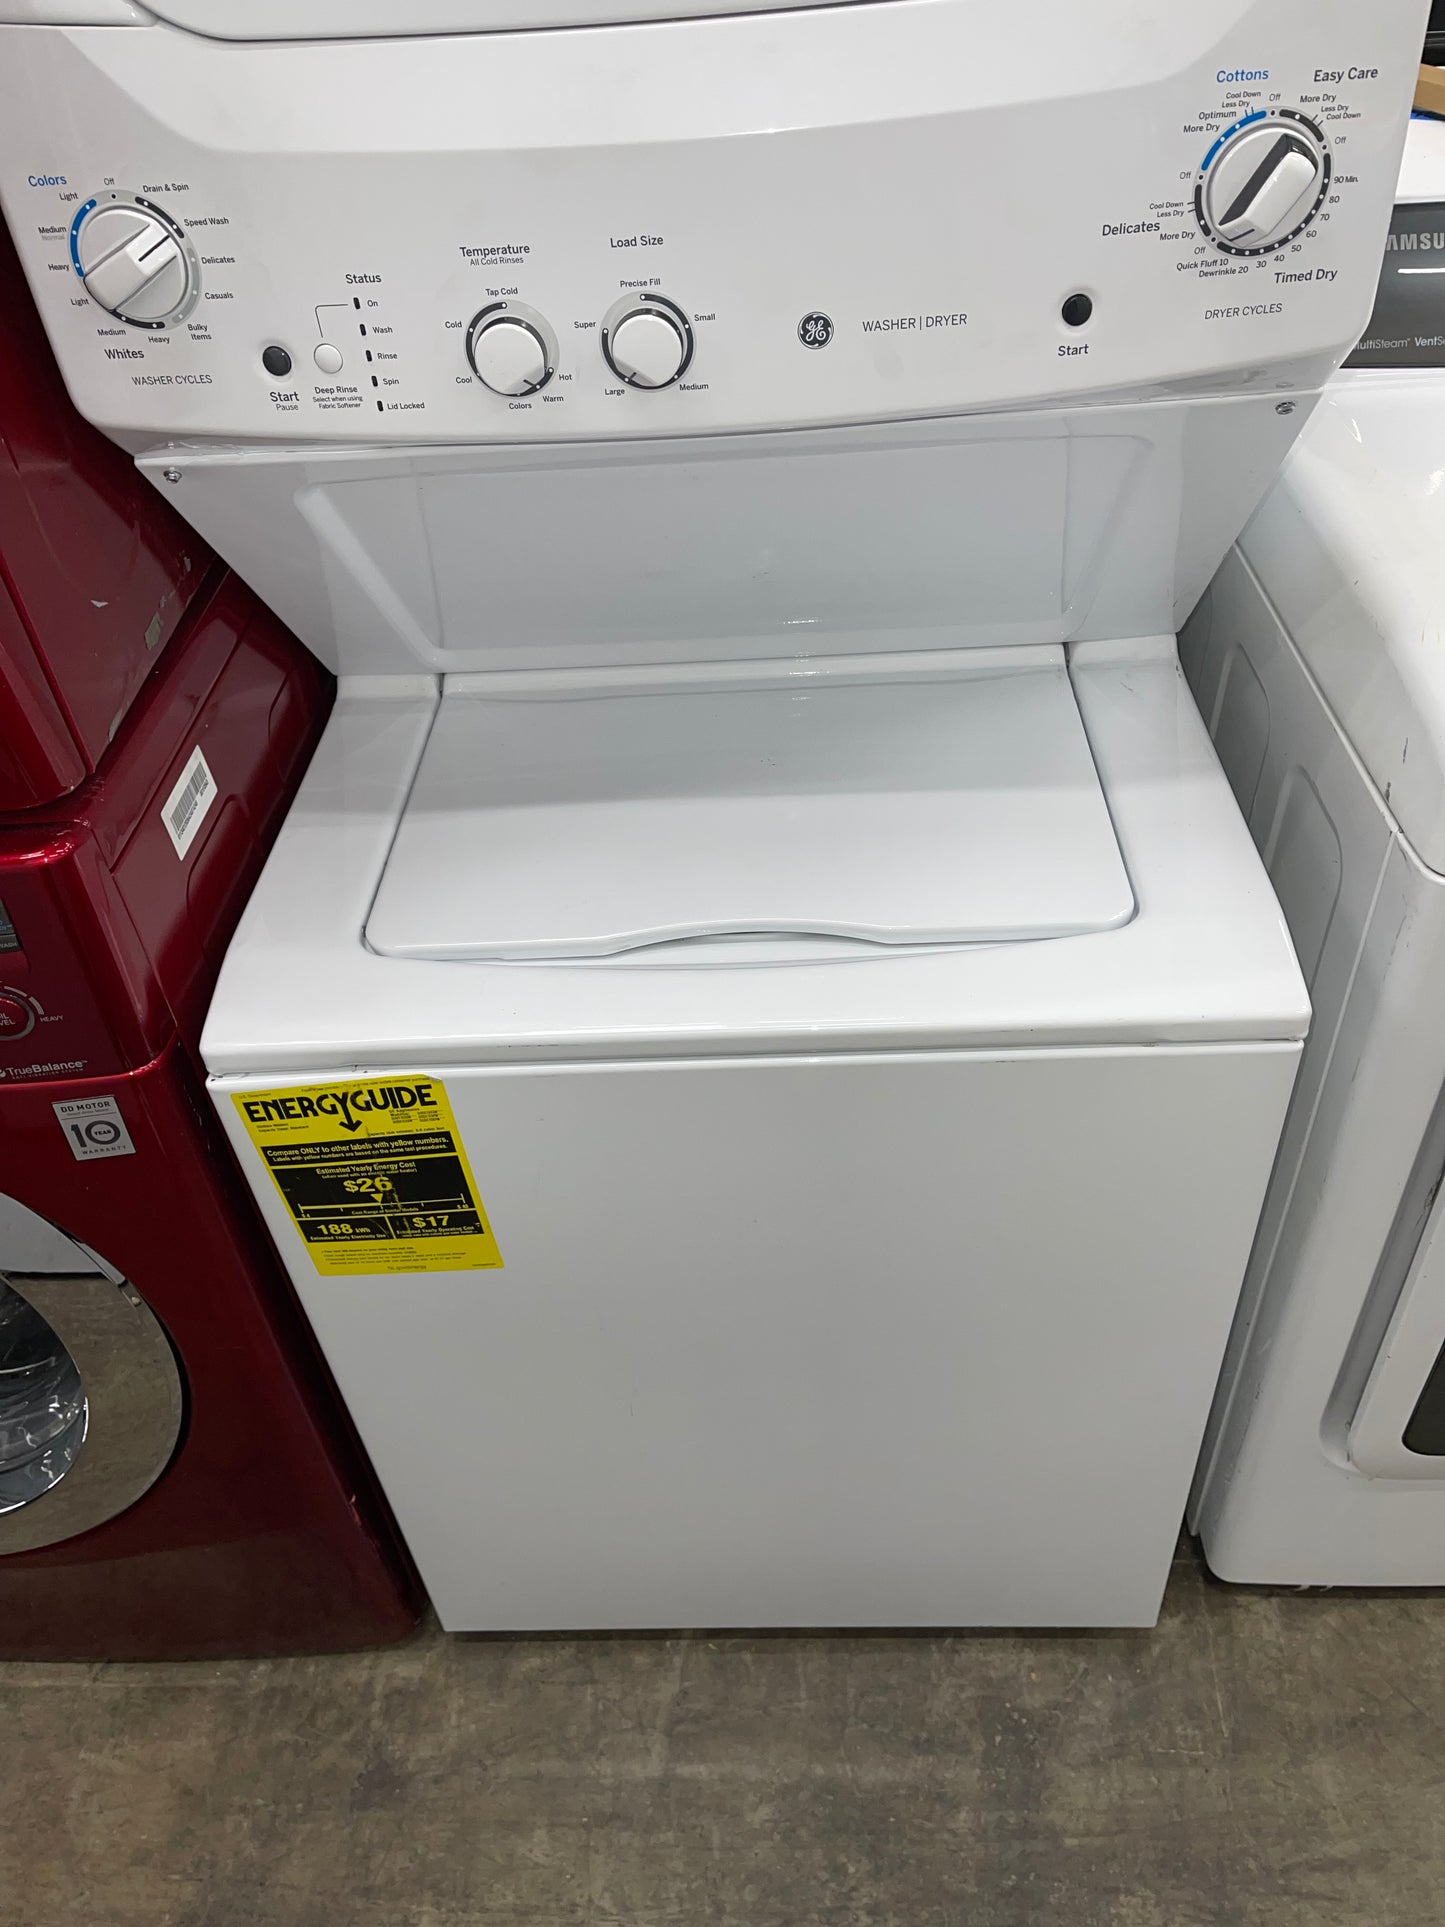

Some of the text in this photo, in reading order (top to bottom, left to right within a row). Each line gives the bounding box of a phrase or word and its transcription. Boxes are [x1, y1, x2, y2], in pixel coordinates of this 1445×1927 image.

[1216, 69, 1269, 83] Cottons
[1313, 67, 1378, 84] Easy Care
[1269, 93, 1281, 102] Off
[1300, 94, 1336, 103] More Dry
[1237, 100, 1250, 109] Dry
[1321, 104, 1349, 113] Less Dry
[1198, 110, 1237, 120] Optimum
[1183, 123, 1220, 133] More Dry
[1335, 137, 1347, 145] Off
[1179, 172, 1192, 180] Off
[1334, 176, 1344, 184] 90
[28, 175, 67, 187] Colors
[104, 177, 115, 185] Off
[143, 183, 189, 193] Drain & Spin
[59, 192, 78, 201] Light
[1328, 196, 1340, 204] 80
[1149, 202, 1164, 210] Cool
[1157, 209, 1185, 218] Less Dry
[1320, 213, 1330, 221] 70
[184, 217, 229, 227] Speed Wash
[38, 226, 67, 234] Medium
[1102, 221, 1160, 236] Delicates
[1159, 231, 1196, 241] More Dry
[1305, 230, 1317, 238] 60
[610, 236, 664, 248] Load Size
[459, 244, 530, 259] Temperature
[1194, 247, 1206, 255] Off
[1291, 244, 1302, 252] 50
[201, 256, 235, 264] Delicates
[469, 256, 524, 266] All Cold Rinses
[1274, 254, 1285, 262] 40
[48, 264, 70, 272] Heavy
[1176, 258, 1229, 271] Quick Fluff 10
[1256, 260, 1267, 268] 30
[1198, 266, 1249, 278] Dewrinkle 20
[1274, 268, 1338, 284] Timed Dry
[345, 273, 382, 284] Status
[619, 278, 661, 288] Precise Fill
[204, 292, 234, 300] Casuals
[485, 287, 518, 297] Tap Cold
[70, 298, 89, 307] Light
[1204, 303, 1283, 320] DRYER CYCLES
[694, 313, 716, 322] Small
[187, 323, 208, 332] Bulky
[445, 321, 463, 329] Cold
[574, 321, 596, 330] Super
[862, 314, 967, 332] WASHER DRYER
[97, 328, 126, 336] Medium
[372, 326, 393, 334] Wash
[148, 336, 170, 345] Heavy
[104, 349, 145, 360] Whites
[1058, 344, 1089, 356] Start
[132, 374, 213, 386] WASHER CYCLES
[382, 378, 399, 386] Spin
[455, 376, 472, 384] Cool
[314, 386, 335, 394] Deep
[679, 382, 709, 391] Medium
[604, 387, 625, 396] Large
[269, 391, 299, 402] Start
[542, 395, 564, 403] Warm
[508, 402, 532, 410] Colors
[60, 1105, 74, 1113] DD
[76, 1101, 111, 1110] MOTOR
[242, 1084, 437, 1124] ENERGYGUIDE
[82, 1145, 126, 1155] WARRANTY
[267, 1149, 299, 1157] Compare
[300, 1146, 321, 1154] ONLY
[373, 1141, 389, 1149] with
[390, 1140, 413, 1148] yellow
[415, 1137, 449, 1145] numbers.
[316, 1166, 351, 1175] Estimated
[351, 1165, 373, 1174] Yearly
[373, 1163, 398, 1171] Energy
[343, 1176, 393, 1193] $26
[412, 1215, 449, 1228] $17
[317, 1223, 353, 1235] 188
